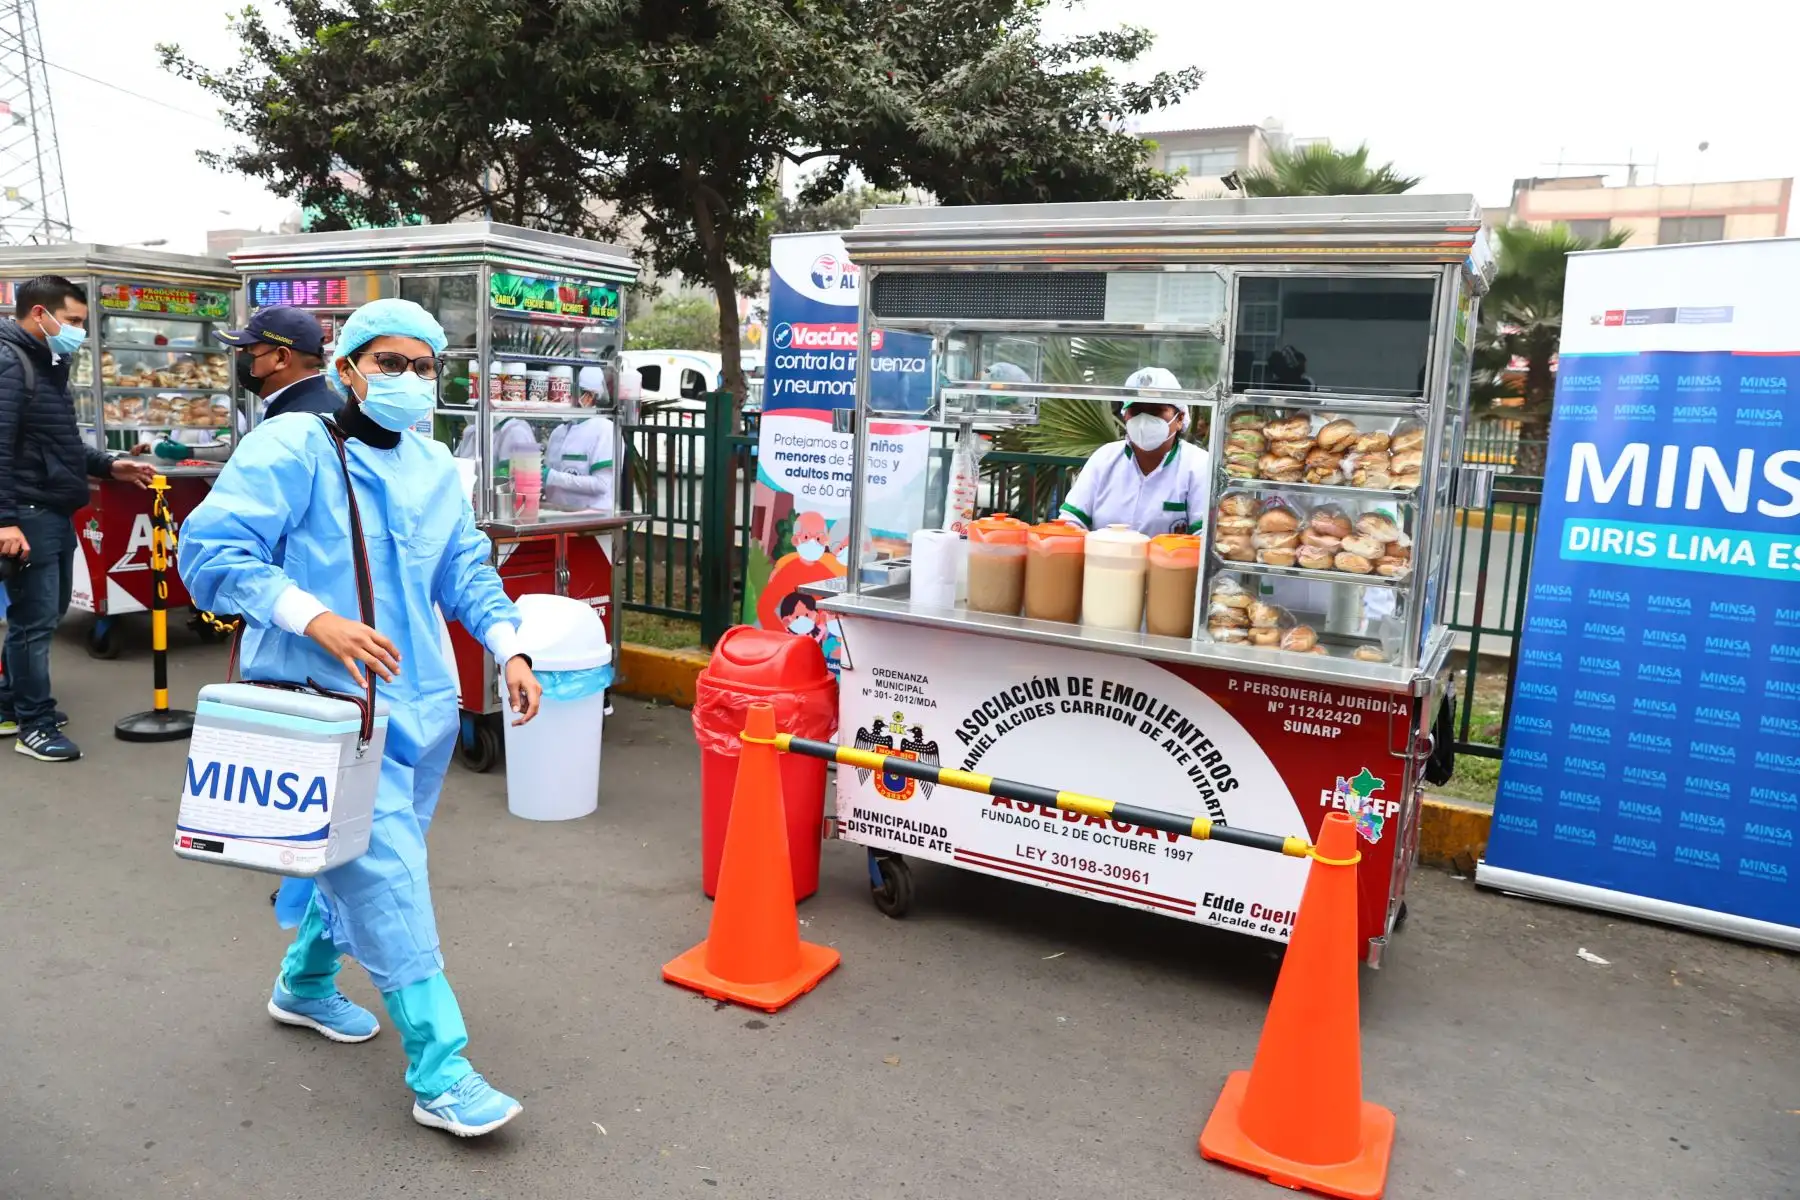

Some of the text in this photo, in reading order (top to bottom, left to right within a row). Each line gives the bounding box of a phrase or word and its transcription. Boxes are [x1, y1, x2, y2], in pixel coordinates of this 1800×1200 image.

[775, 353, 828, 370] contra
[830, 352, 845, 370] la
[773, 379, 783, 396] y
[774, 433, 904, 453] Protejamos a niños
[775, 451, 826, 464] menores
[829, 454, 845, 466] de
[893, 460, 900, 472] y
[785, 467, 888, 485] adultos mares
[802, 483, 852, 498] de 60 añ
[1568, 526, 1657, 557] DIRIS
[1667, 533, 1756, 567] LIMA
[1535, 584, 1572, 596] MINSA
[1588, 588, 1630, 602] MINSA
[1648, 595, 1692, 609] MINSA
[1709, 601, 1756, 616] MINSA
[1530, 616, 1567, 629] MINSA
[1584, 622, 1625, 636] MINSA
[1643, 629, 1687, 643] MINSA
[1705, 636, 1751, 652] MINSA
[872, 668, 929, 684] ORDENANZA
[1524, 649, 1562, 662] MINSA
[1580, 656, 1621, 670] MINSA
[1638, 663, 1682, 678] MINSA
[1700, 670, 1746, 686] MINSA
[876, 679, 924, 695] MUNICIPAL
[894, 693, 937, 709] 2012/MDA
[1228, 679, 1408, 716] P. PERSONERÍA JURÍDICA
[1519, 681, 1558, 696] MINSA
[1574, 689, 1616, 704] MINSA
[1633, 698, 1677, 713] MINSA
[1695, 706, 1741, 722] MINSA
[1283, 720, 1341, 739] SUNARP
[1289, 704, 1362, 726] 11242420
[955, 676, 1239, 793] ASOCIACIÓN DE EMOLIENTEROS
[995, 702, 1055, 737] ALCIDES
[1061, 700, 1137, 727] CARRION
[1139, 720, 1163, 742] DE
[1161, 739, 1192, 766] ATE
[1515, 714, 1552, 729] MINSA
[1569, 723, 1611, 738] MINSA
[1628, 732, 1672, 747] MINSA
[1690, 741, 1736, 757] MINSA
[185, 757, 328, 813] MINSA
[1509, 747, 1798, 804] MINSA MINSA MINSA MINSA MINSA
[853, 808, 947, 838] MUNICIPALIDAD
[1504, 780, 1793, 840] MINSA MINSA MINSA MINSA MINSA
[929, 838, 952, 853] ATE
[981, 808, 1193, 862] FUNDADO EL 2 DE OCTUBRE 1997
[1499, 813, 1538, 829] MINSA
[1554, 824, 1596, 840] MINSA
[1613, 834, 1657, 851] MINSA
[1674, 846, 1720, 863] MINSA
[1016, 843, 1150, 885] LEY 30198-30961
[1202, 892, 1297, 926] Edde Cuell
[1207, 911, 1256, 930] Alcalde
[1260, 923, 1276, 934] de
